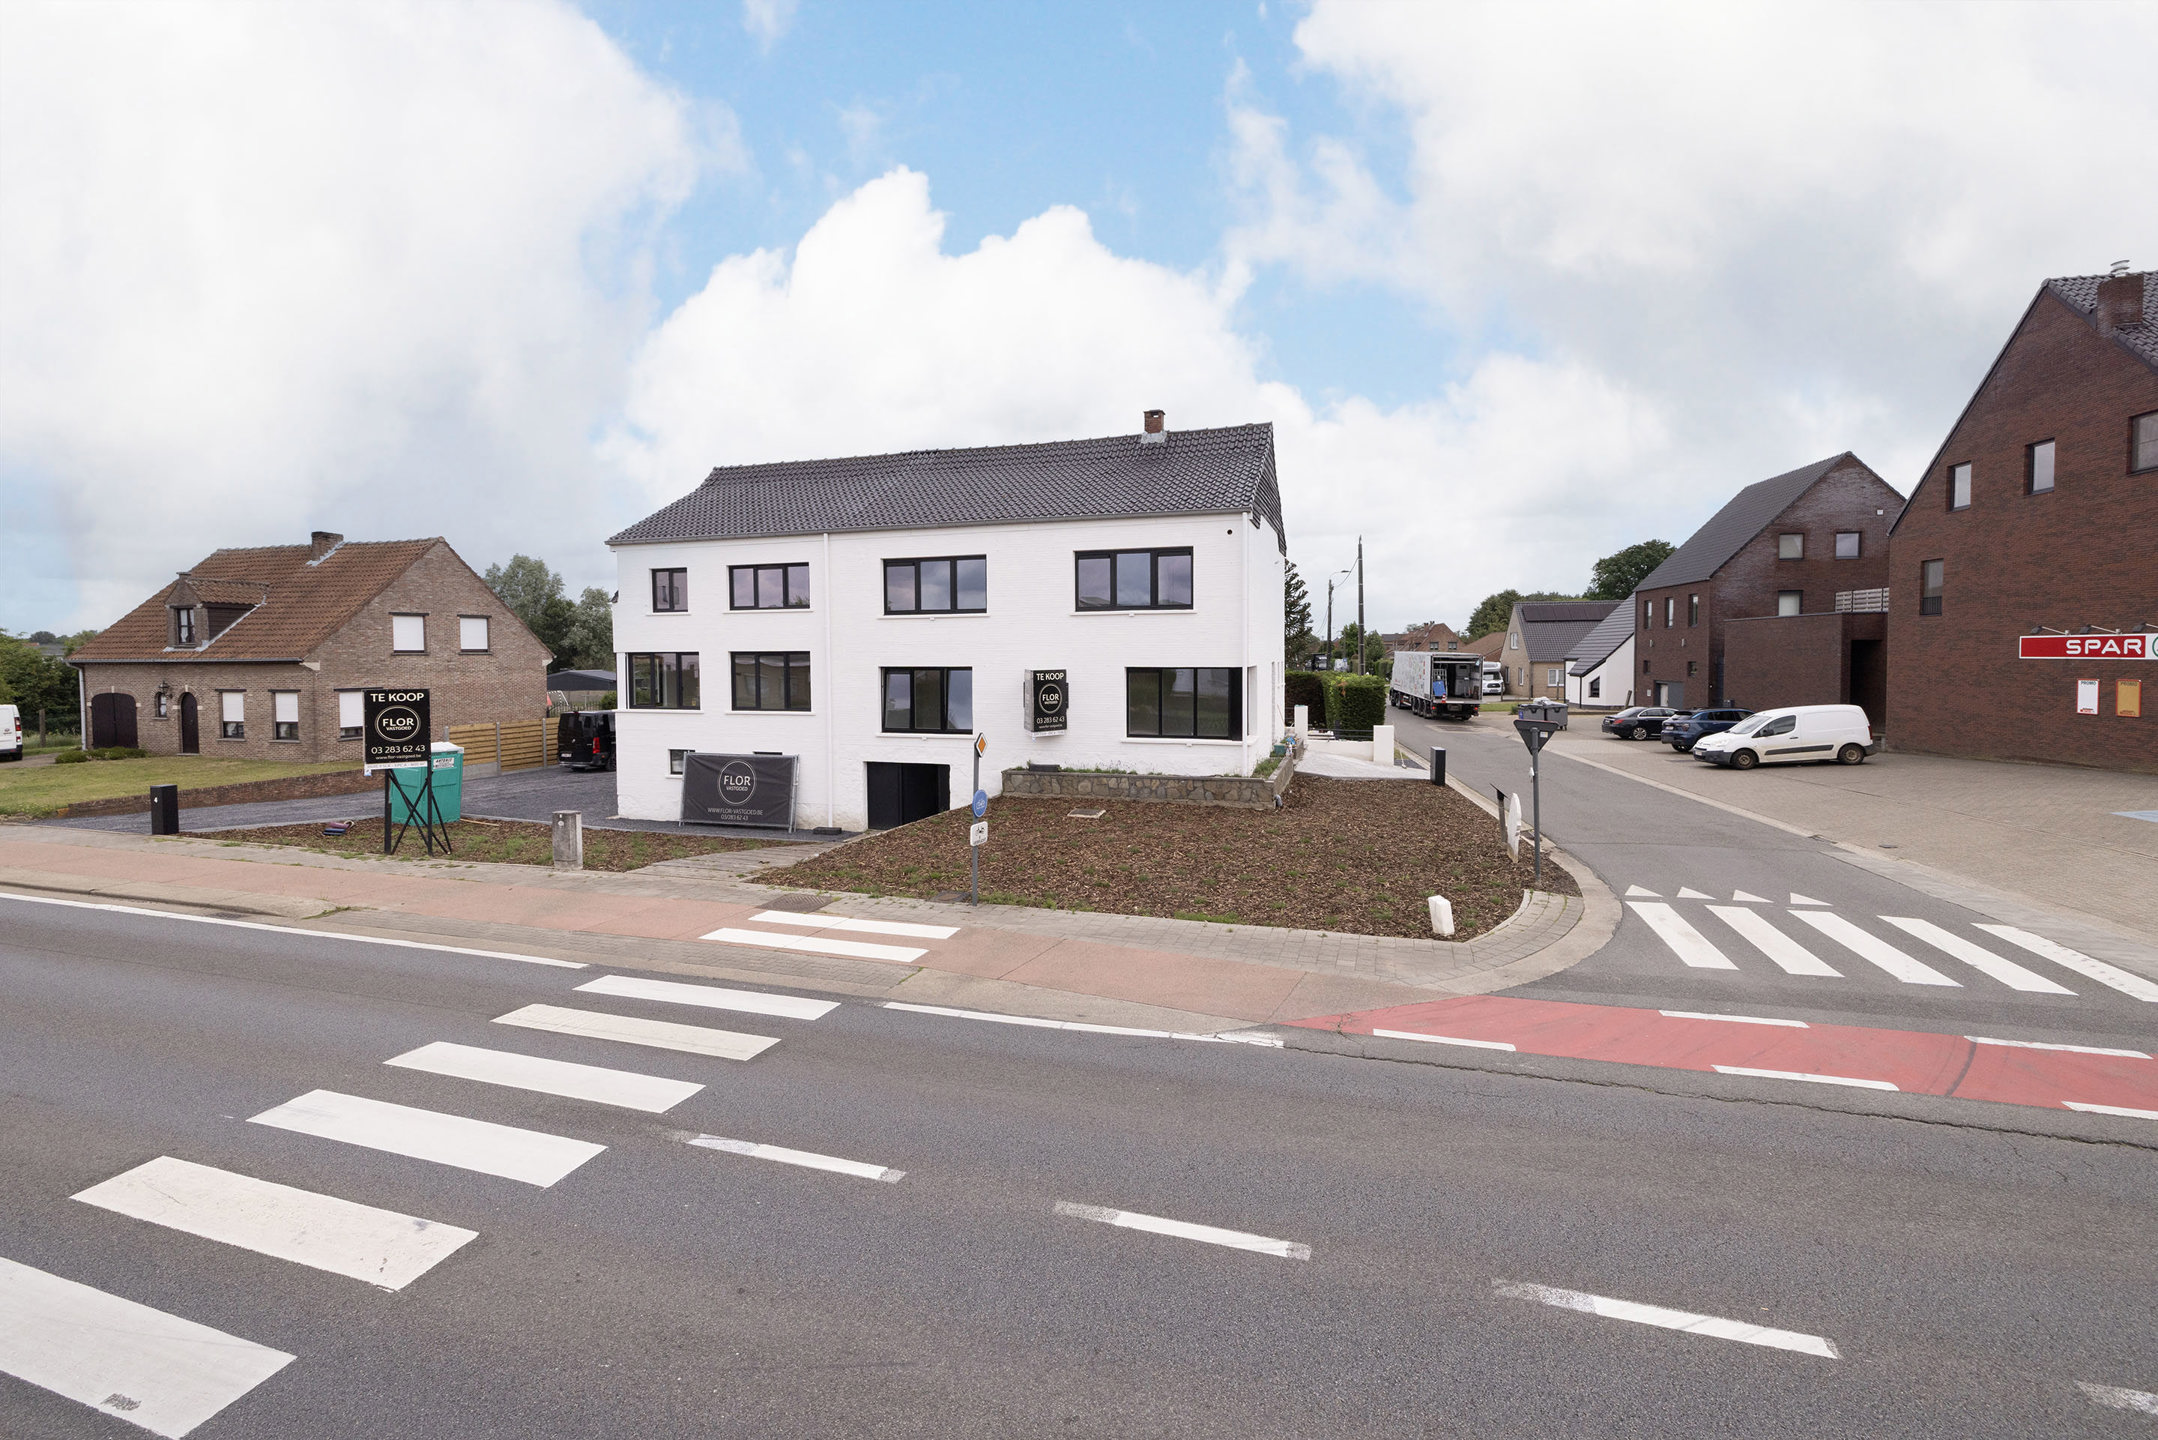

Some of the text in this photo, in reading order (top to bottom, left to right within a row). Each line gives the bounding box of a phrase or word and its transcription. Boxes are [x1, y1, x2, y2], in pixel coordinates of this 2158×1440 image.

[2066, 639, 2142, 655] SPAR
[1045, 672, 1064, 680] KOOP
[370, 692, 424, 702] TE KOOP
[1042, 693, 1059, 701] FLOR
[382, 718, 414, 726] FLOR
[371, 744, 426, 755] 03 283 62 43
[724, 776, 750, 786] FLOR
